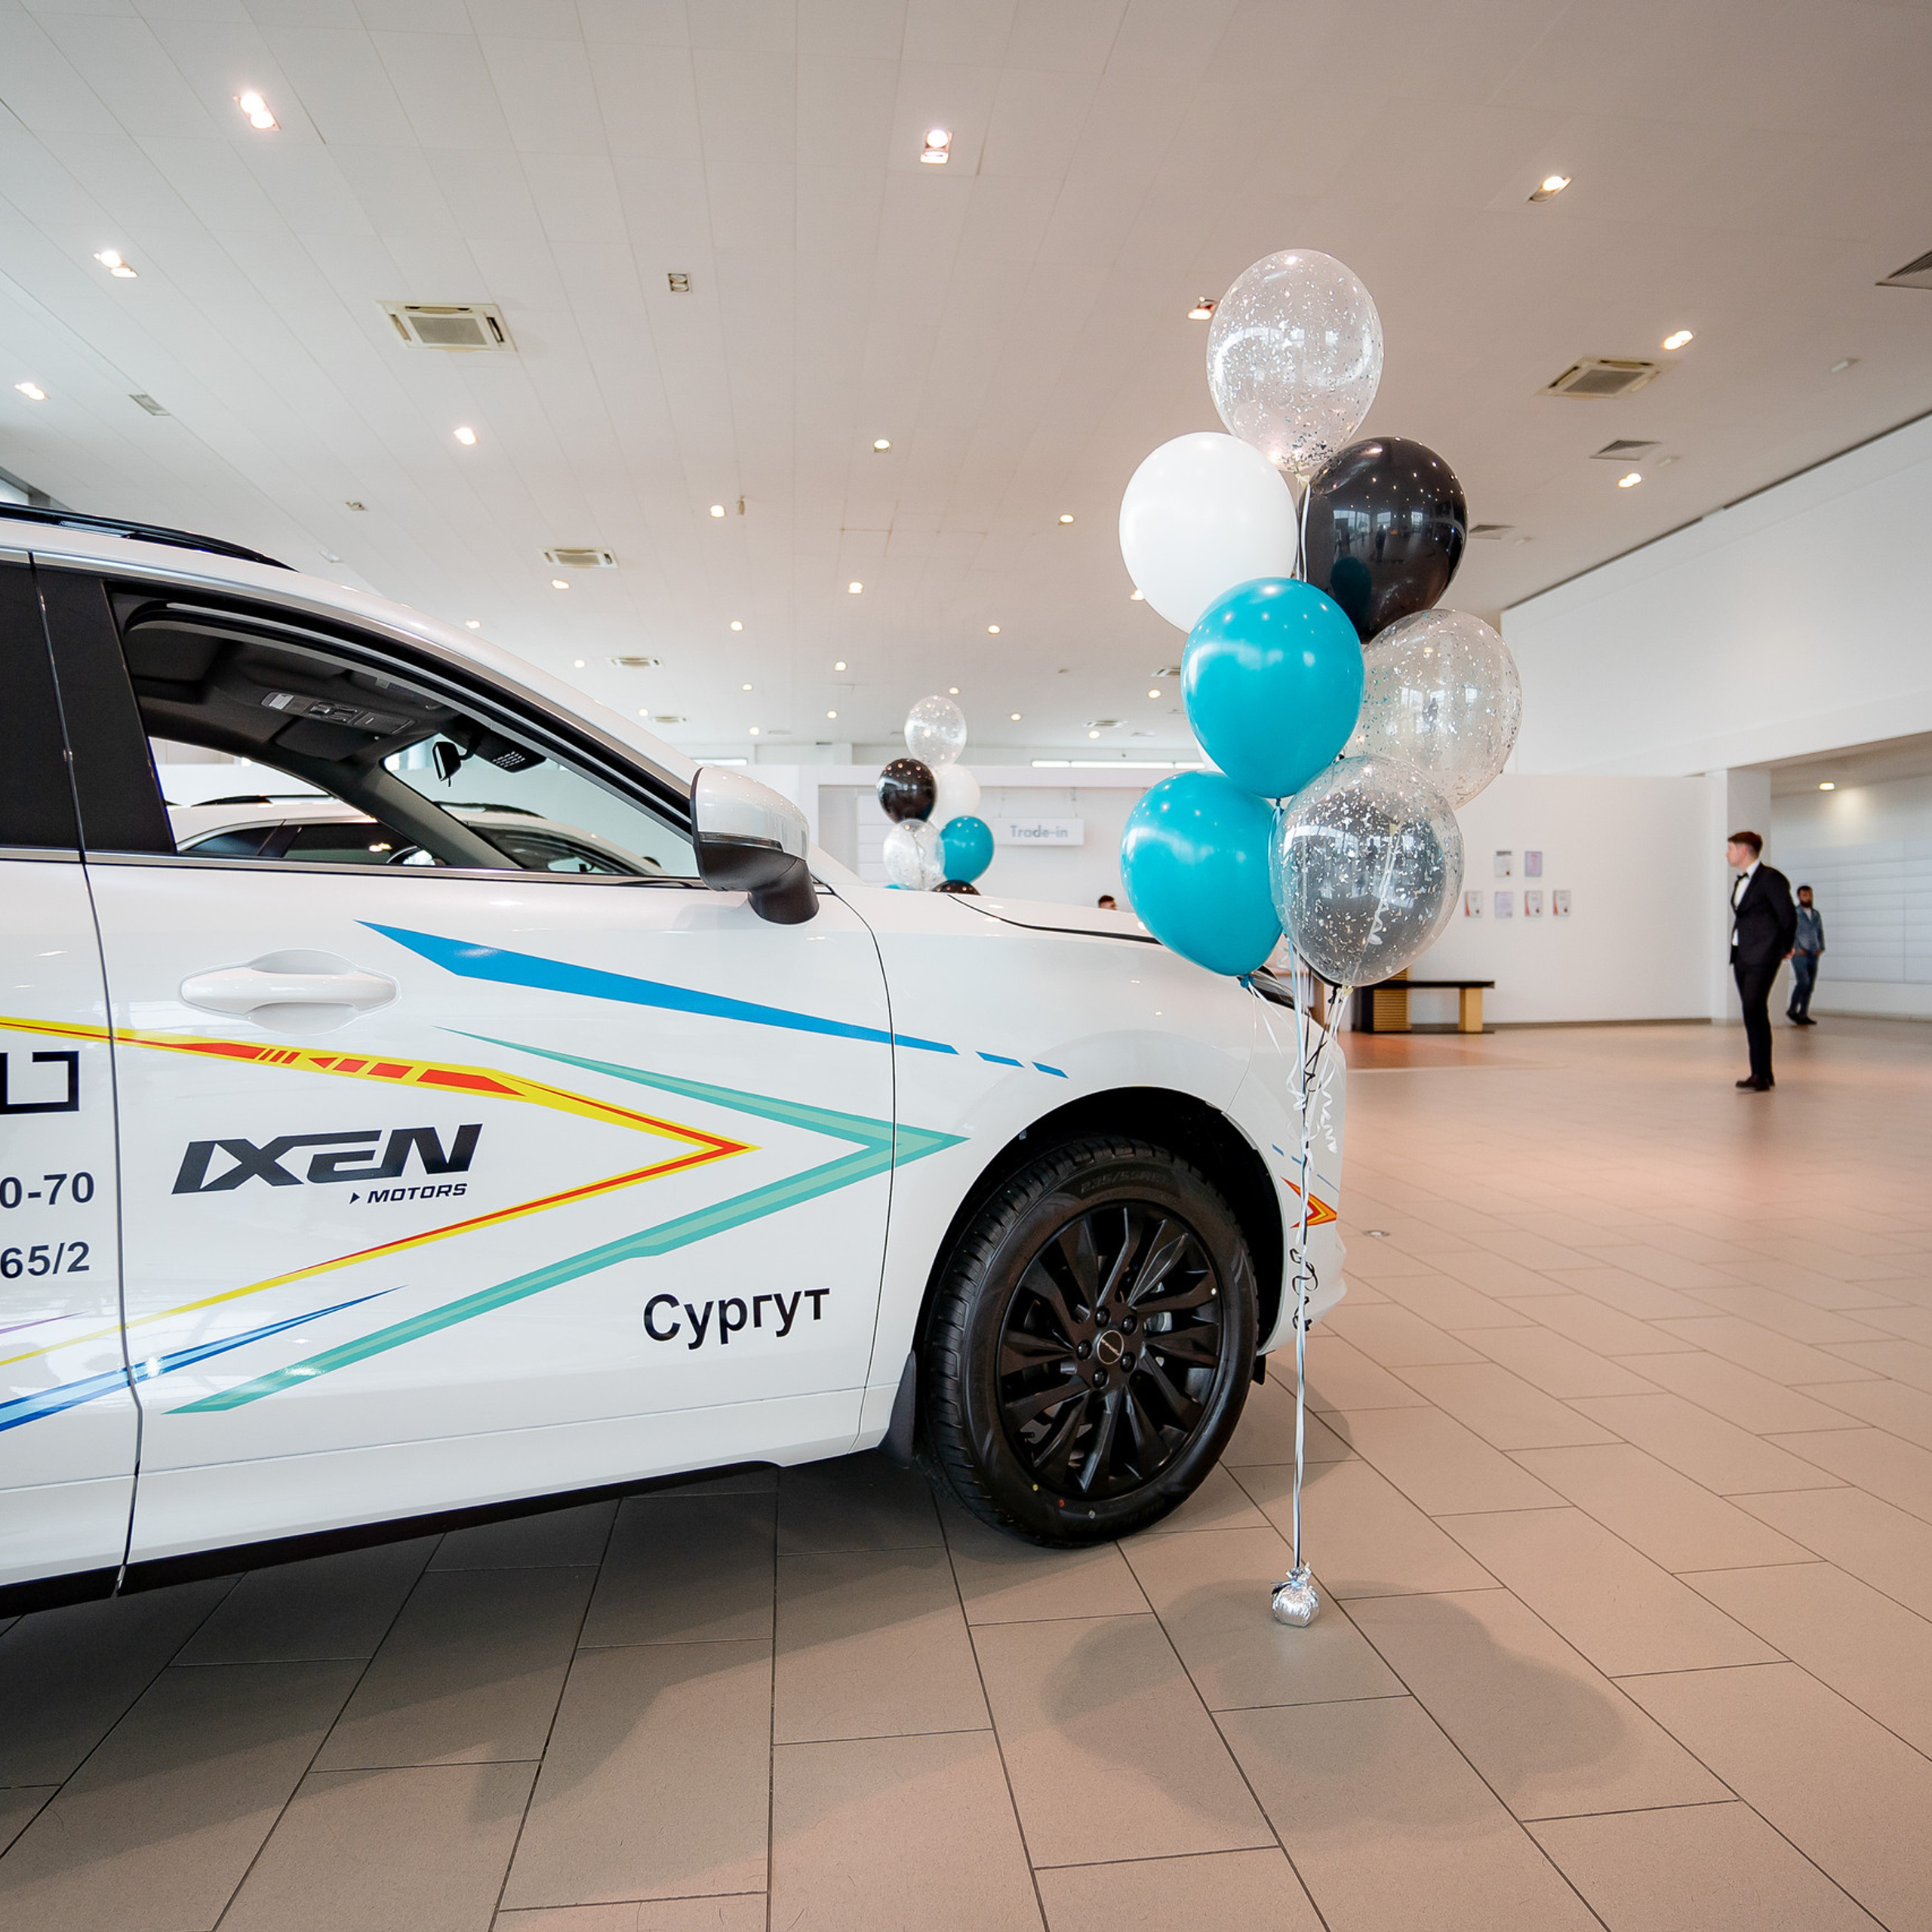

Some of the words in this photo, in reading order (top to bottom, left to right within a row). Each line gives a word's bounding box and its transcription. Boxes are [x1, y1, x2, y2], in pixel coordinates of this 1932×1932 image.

[1010, 825, 1069, 838] Trade-in
[0, 1171, 94, 1209] 0-70
[367, 1183, 468, 1204] MOTORS
[0, 1241, 90, 1279] 65/2
[643, 1287, 830, 1350] Сургут
